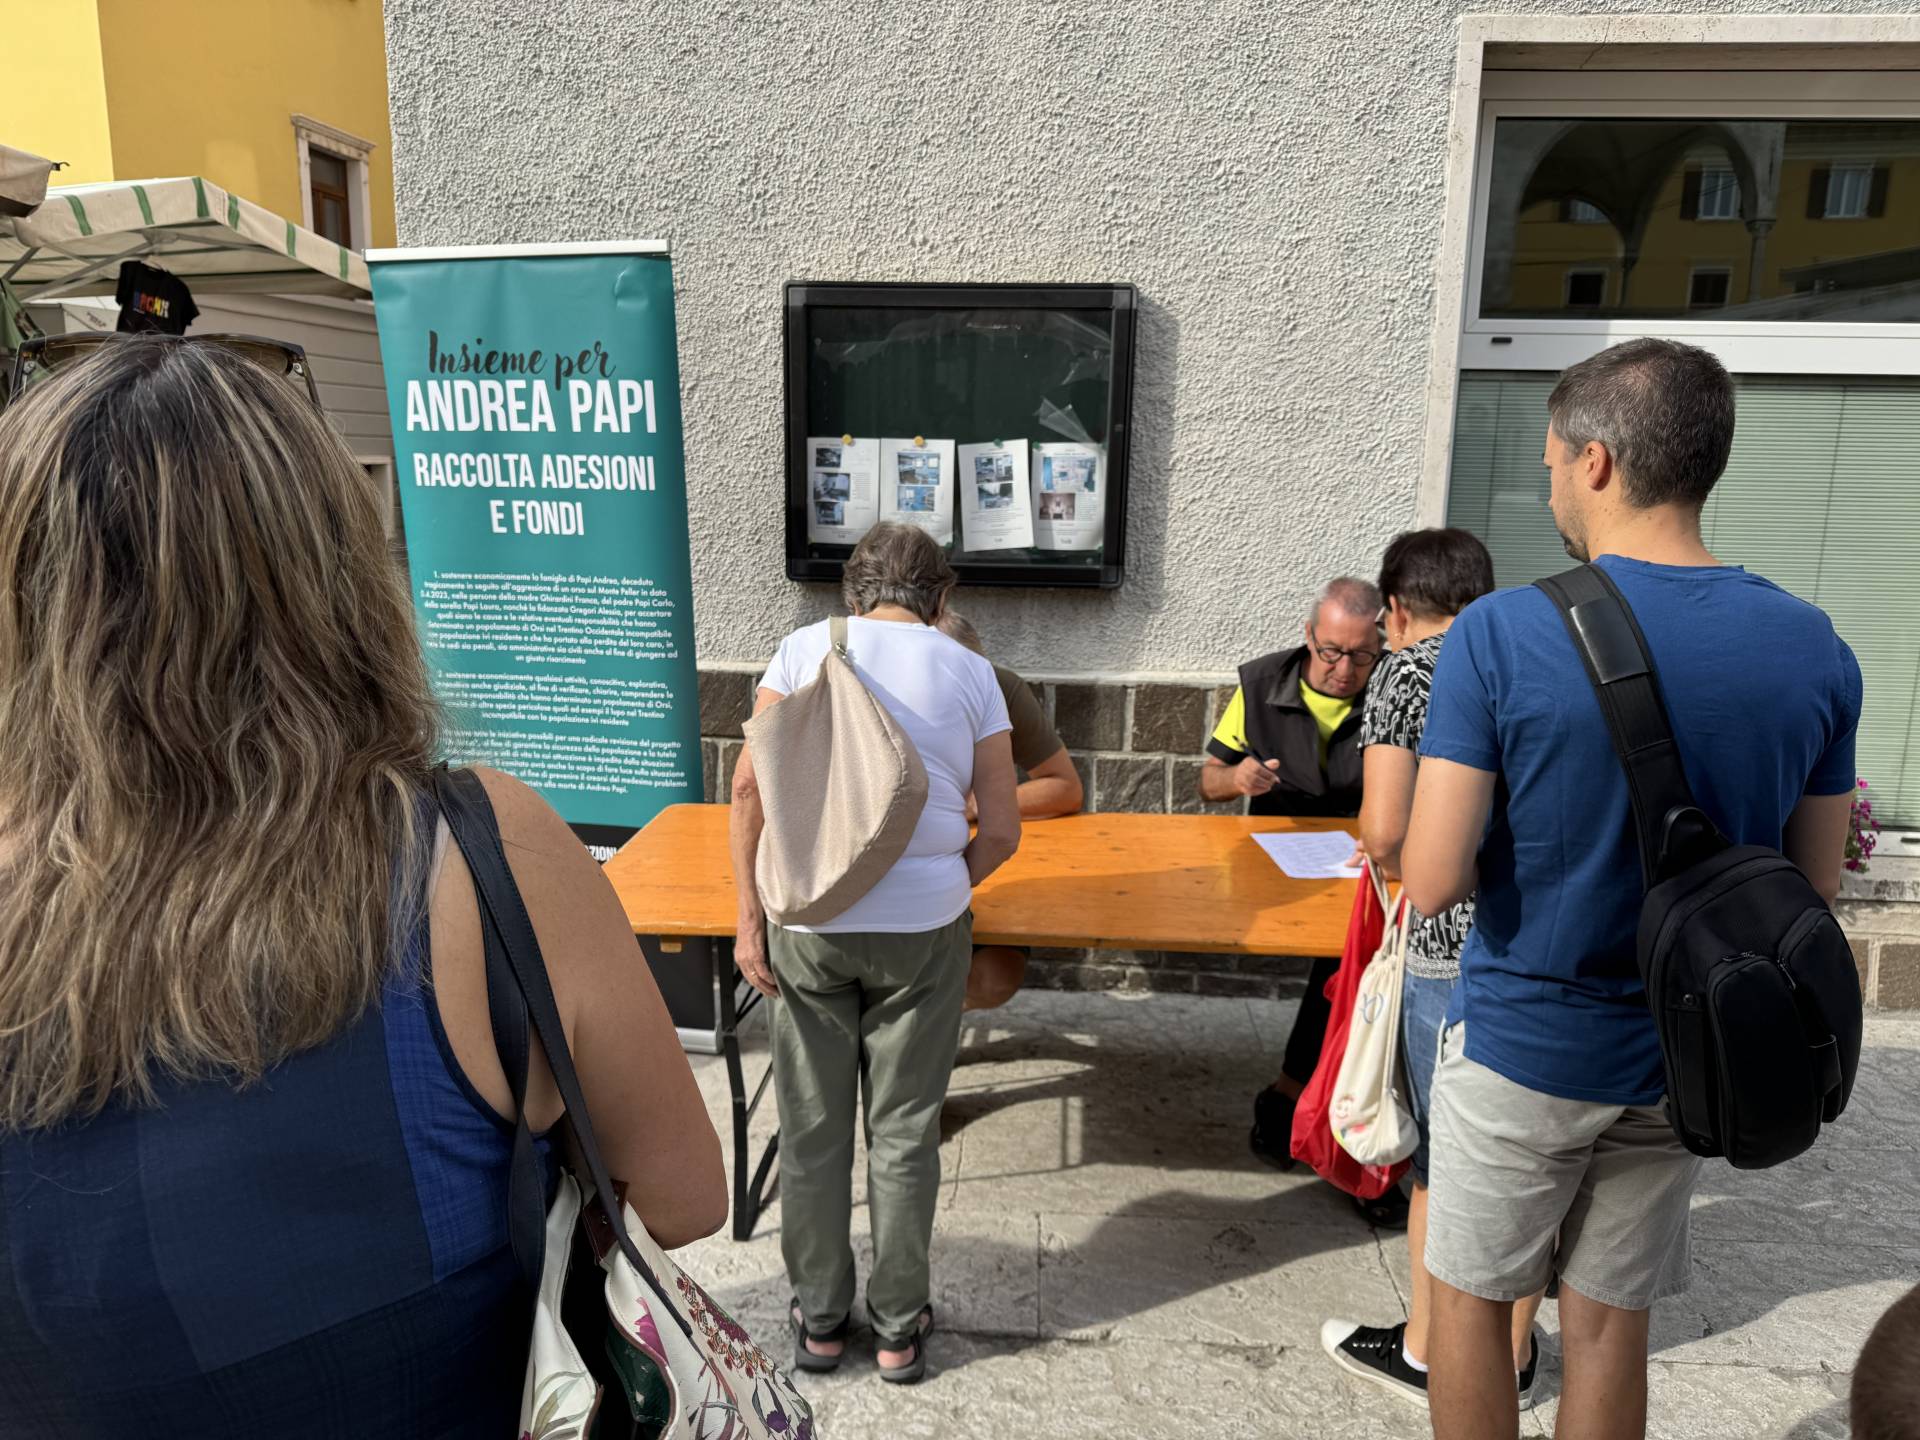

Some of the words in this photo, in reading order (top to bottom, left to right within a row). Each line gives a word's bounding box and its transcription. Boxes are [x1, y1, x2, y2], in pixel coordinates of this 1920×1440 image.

[428, 329, 547, 376] Insieme
[555, 341, 616, 391] per
[406, 379, 556, 432] ANDREA
[568, 379, 657, 434] PAPI
[412, 452, 535, 489] RACCOLTA
[541, 454, 656, 491] ADESIONI
[489, 499, 507, 534] E
[511, 500, 585, 536] FONDI
[473, 572, 530, 580] economicamente
[540, 573, 566, 583] famiglia
[576, 575, 591, 585] Papi
[592, 575, 619, 585] Andrea,
[620, 577, 653, 586] deceduto
[474, 582, 499, 591] seguito
[597, 586, 618, 594] Monte
[649, 588, 667, 596] data
[451, 591, 467, 599] nelle
[469, 593, 496, 601] persone
[498, 592, 515, 600] della
[601, 596, 611, 604] del
[613, 597, 632, 606] padre
[634, 598, 650, 608] Papi
[651, 598, 675, 608] Carlo,
[440, 601, 461, 609] sorella
[463, 602, 478, 611] Papi
[479, 602, 501, 611] Laura,
[624, 609, 635, 617] per
[437, 611, 453, 621] quali
[517, 614, 542, 622] relative
[543, 615, 572, 623] eventuali
[574, 617, 619, 626] responsabilità
[621, 618, 632, 626] che
[634, 619, 657, 627] hanno
[475, 622, 520, 632] popolamento
[530, 624, 544, 632] Orsi
[557, 625, 583, 633] Trentino
[585, 626, 623, 635] Occidentale
[625, 628, 672, 639] incompatibile
[439, 631, 480, 640] popolazione
[491, 633, 522, 641] residente
[530, 634, 541, 642] che
[553, 636, 577, 644] portato
[579, 636, 591, 644] alla
[593, 637, 616, 646] perdita
[618, 638, 628, 646] del
[630, 638, 644, 647] loro
[645, 641, 664, 649] caro,
[461, 641, 471, 649] sia
[556, 645, 566, 653] sia
[567, 646, 582, 654] civili
[583, 647, 603, 655] anche
[613, 648, 625, 656] fine
[635, 649, 665, 659] giungere
[667, 651, 678, 659] ad
[525, 654, 544, 663] giusto
[546, 655, 586, 664] risarcimento
[471, 681, 491, 689] anche
[537, 684, 548, 692] fine
[592, 687, 618, 696] chiarire,
[620, 690, 664, 698] comprendere
[477, 672, 532, 681] economicamente
[628, 680, 668, 690] esplorativa,
[469, 692, 515, 700] responsabilità
[530, 693, 550, 701] hanno
[602, 698, 644, 707] popolamento
[655, 700, 672, 710] Orsi,
[482, 710, 525, 721] incompatibile
[548, 714, 588, 723] popolazione
[599, 717, 629, 726] residente
[495, 702, 515, 711] specie
[517, 703, 550, 712] pericolose
[552, 705, 568, 714] quali
[610, 707, 624, 717] lupo
[638, 709, 665, 718] Trentino
